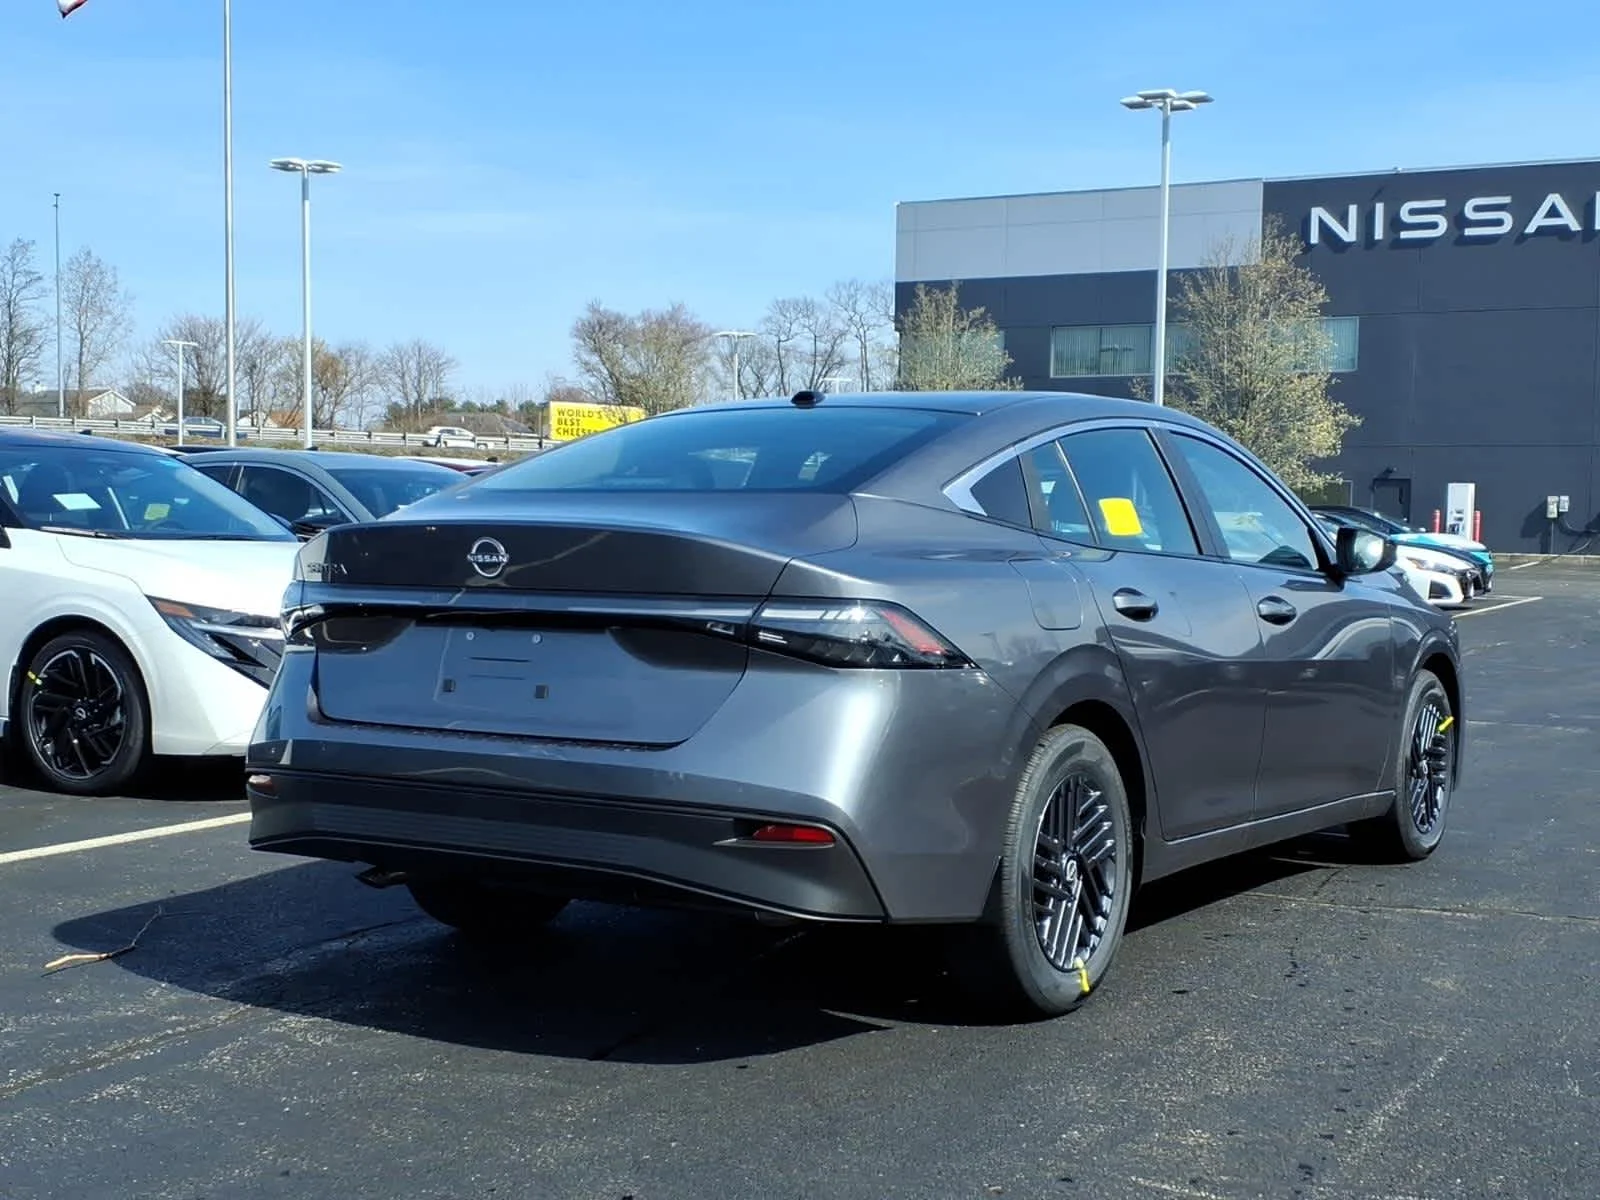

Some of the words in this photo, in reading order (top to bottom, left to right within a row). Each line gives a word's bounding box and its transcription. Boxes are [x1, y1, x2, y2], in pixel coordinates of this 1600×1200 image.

[1309, 191, 1600, 245] NISSA
[557, 408, 602, 419] WORLD'S
[557, 418, 581, 426] BEST
[466, 553, 509, 562] NISSAN
